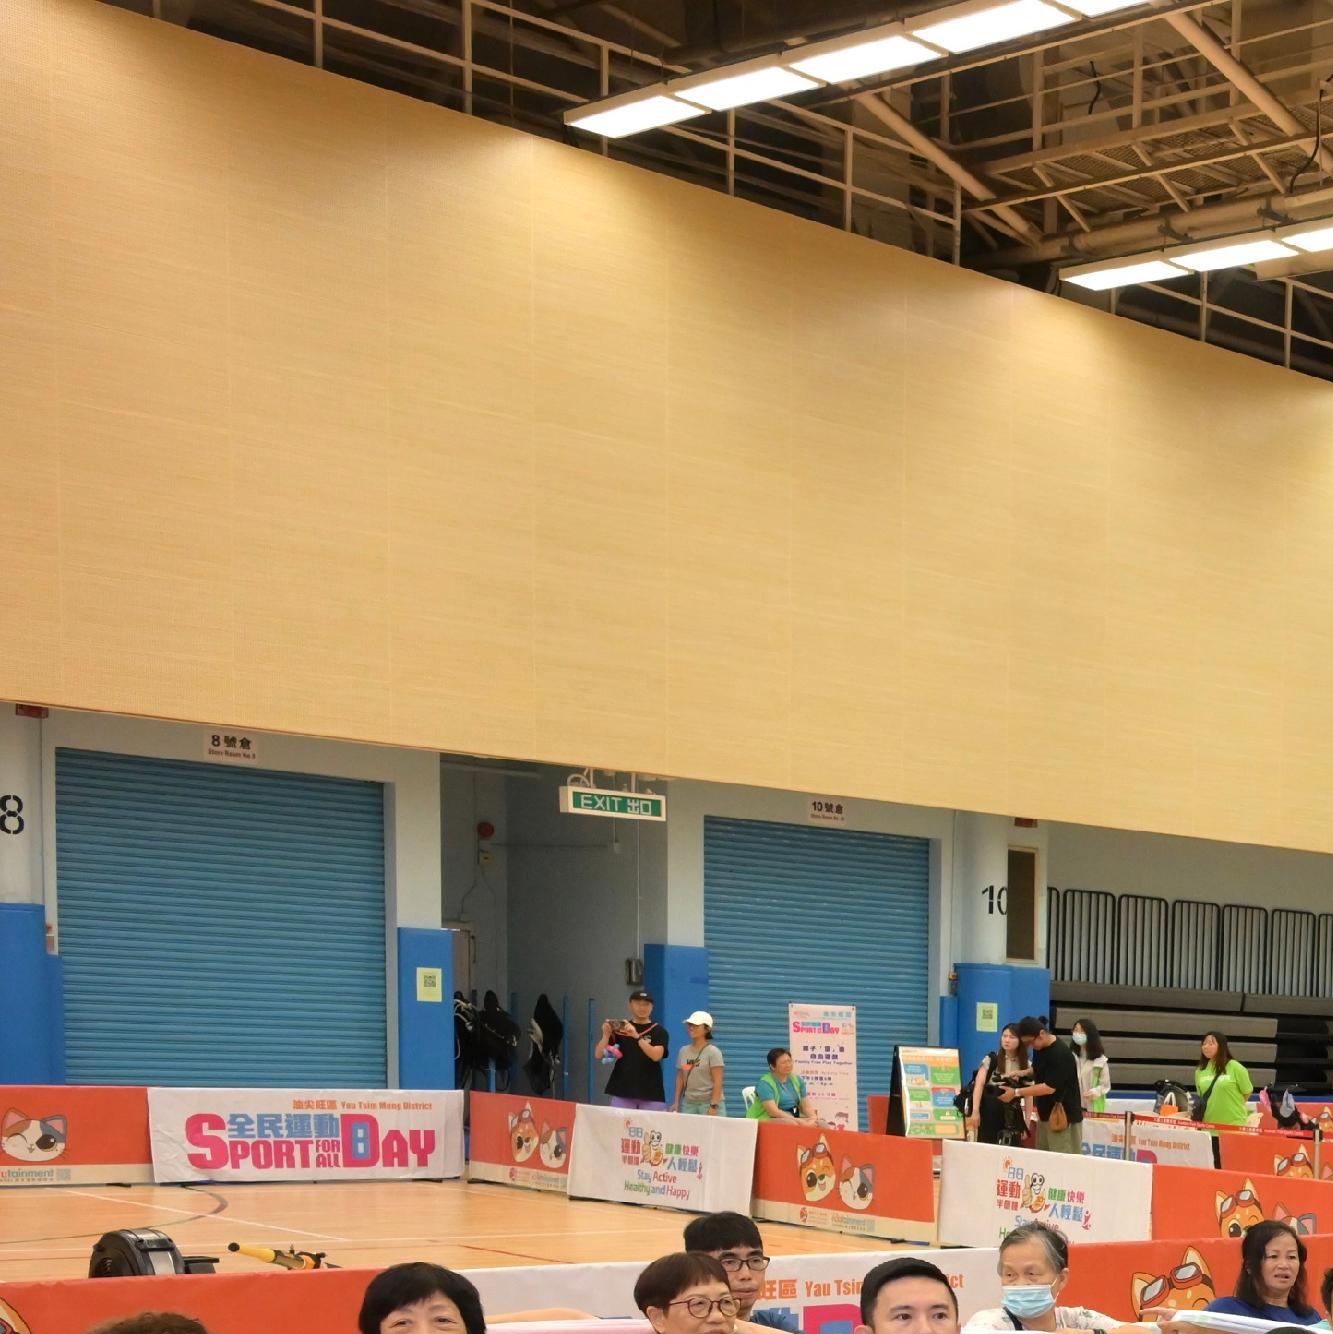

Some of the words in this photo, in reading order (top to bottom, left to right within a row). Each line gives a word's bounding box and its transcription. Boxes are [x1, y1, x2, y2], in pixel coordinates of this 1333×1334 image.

[0, 794, 24, 835] 8
[580, 795, 621, 811] EXIT
[626, 798, 652, 815] 出口
[982, 885, 1007, 915] 10
[228, 1113, 340, 1139] 全民運動
[185, 1113, 314, 1170] SPORT
[315, 1139, 341, 1153] FOR
[341, 1113, 436, 1168] DAY
[315, 1153, 341, 1168] ALL
[637, 1169, 652, 1183] Stay
[652, 1170, 677, 1183] Active
[624, 1179, 650, 1196] Healthy
[651, 1184, 666, 1196] and
[666, 1185, 690, 1200] Happy
[997, 1179, 1021, 1199] 運動
[805, 1281, 830, 1298] Yau
